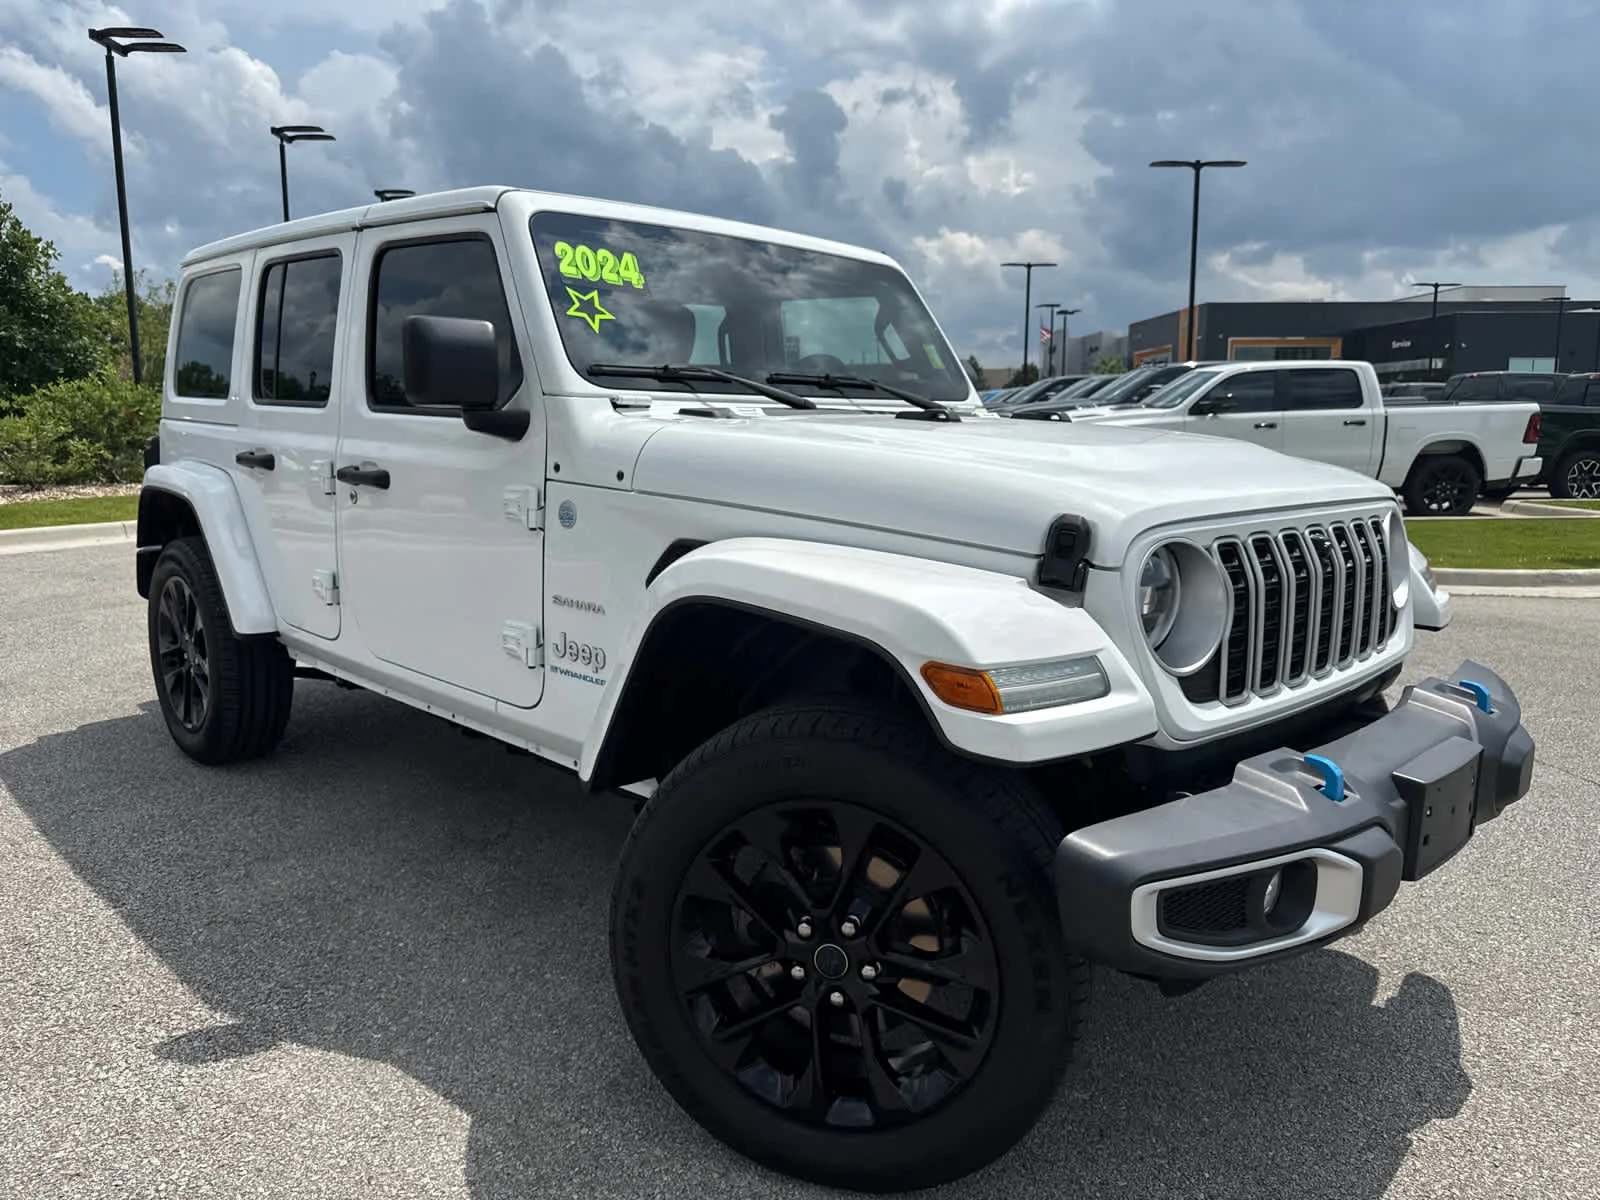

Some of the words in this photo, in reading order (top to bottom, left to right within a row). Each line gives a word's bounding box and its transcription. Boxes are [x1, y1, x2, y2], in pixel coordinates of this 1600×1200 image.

[554, 241, 645, 289] 2024
[552, 594, 607, 616] SAHARA
[552, 631, 606, 674] Jeep
